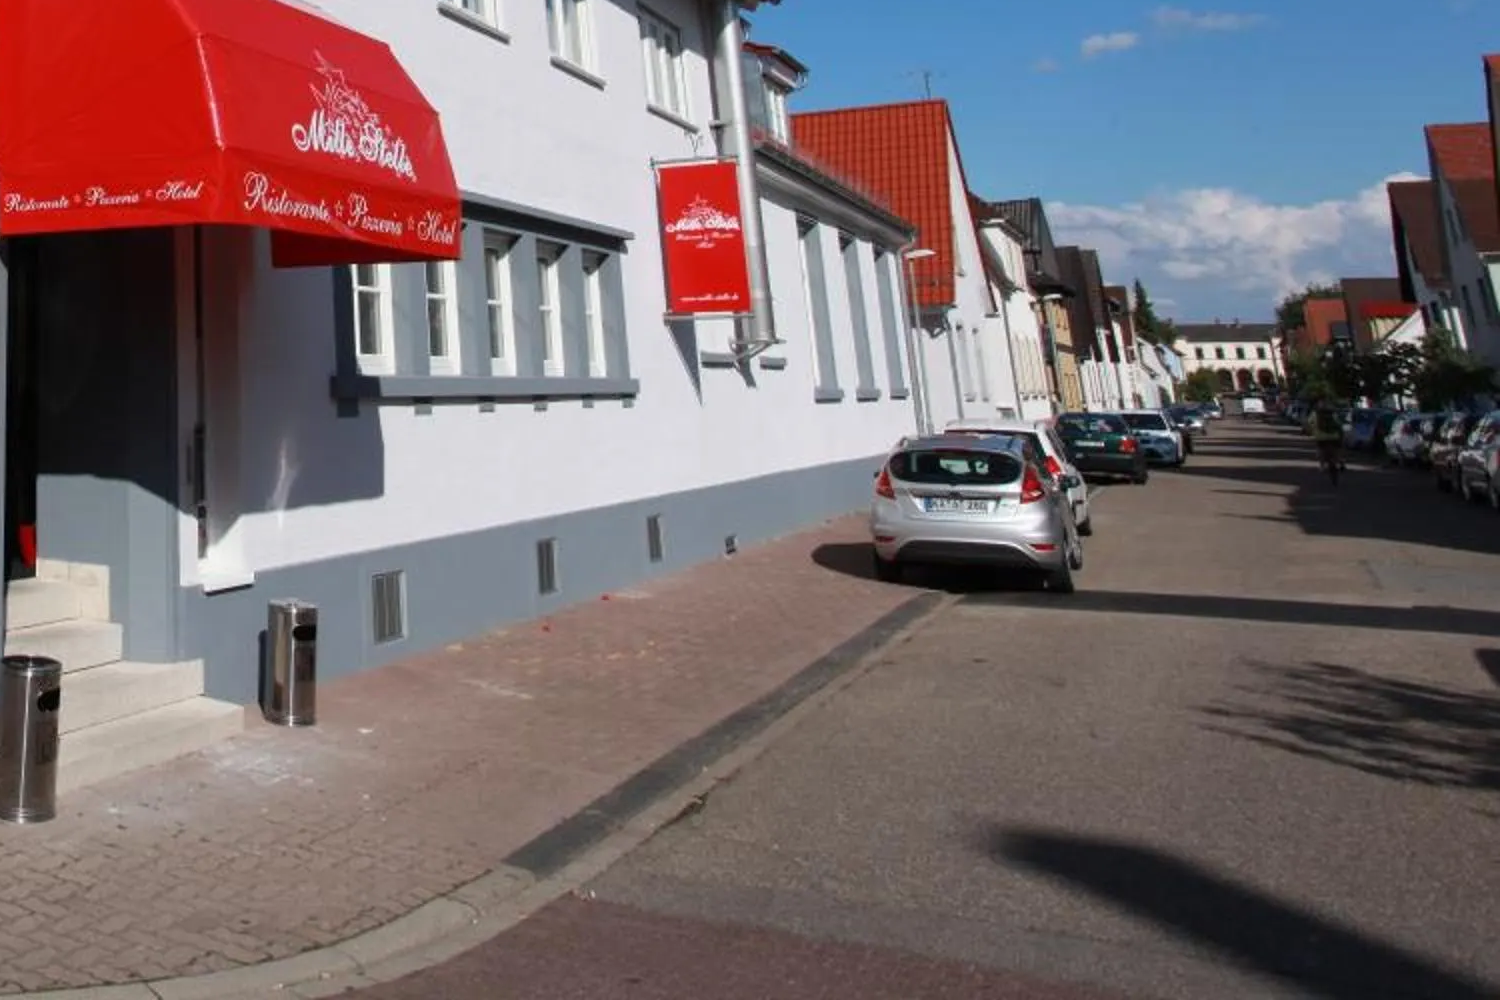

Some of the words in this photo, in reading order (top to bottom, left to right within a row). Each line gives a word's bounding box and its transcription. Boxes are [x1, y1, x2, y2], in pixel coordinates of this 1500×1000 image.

[292, 108, 361, 162] Mille
[358, 121, 417, 183] Stelle
[4, 193, 69, 212] Ristorante
[85, 186, 140, 207] Pizzeria
[155, 181, 204, 201] Hotel
[244, 171, 331, 223] Ristorante
[347, 192, 403, 236] Pizzeria
[417, 210, 457, 245] Hotel
